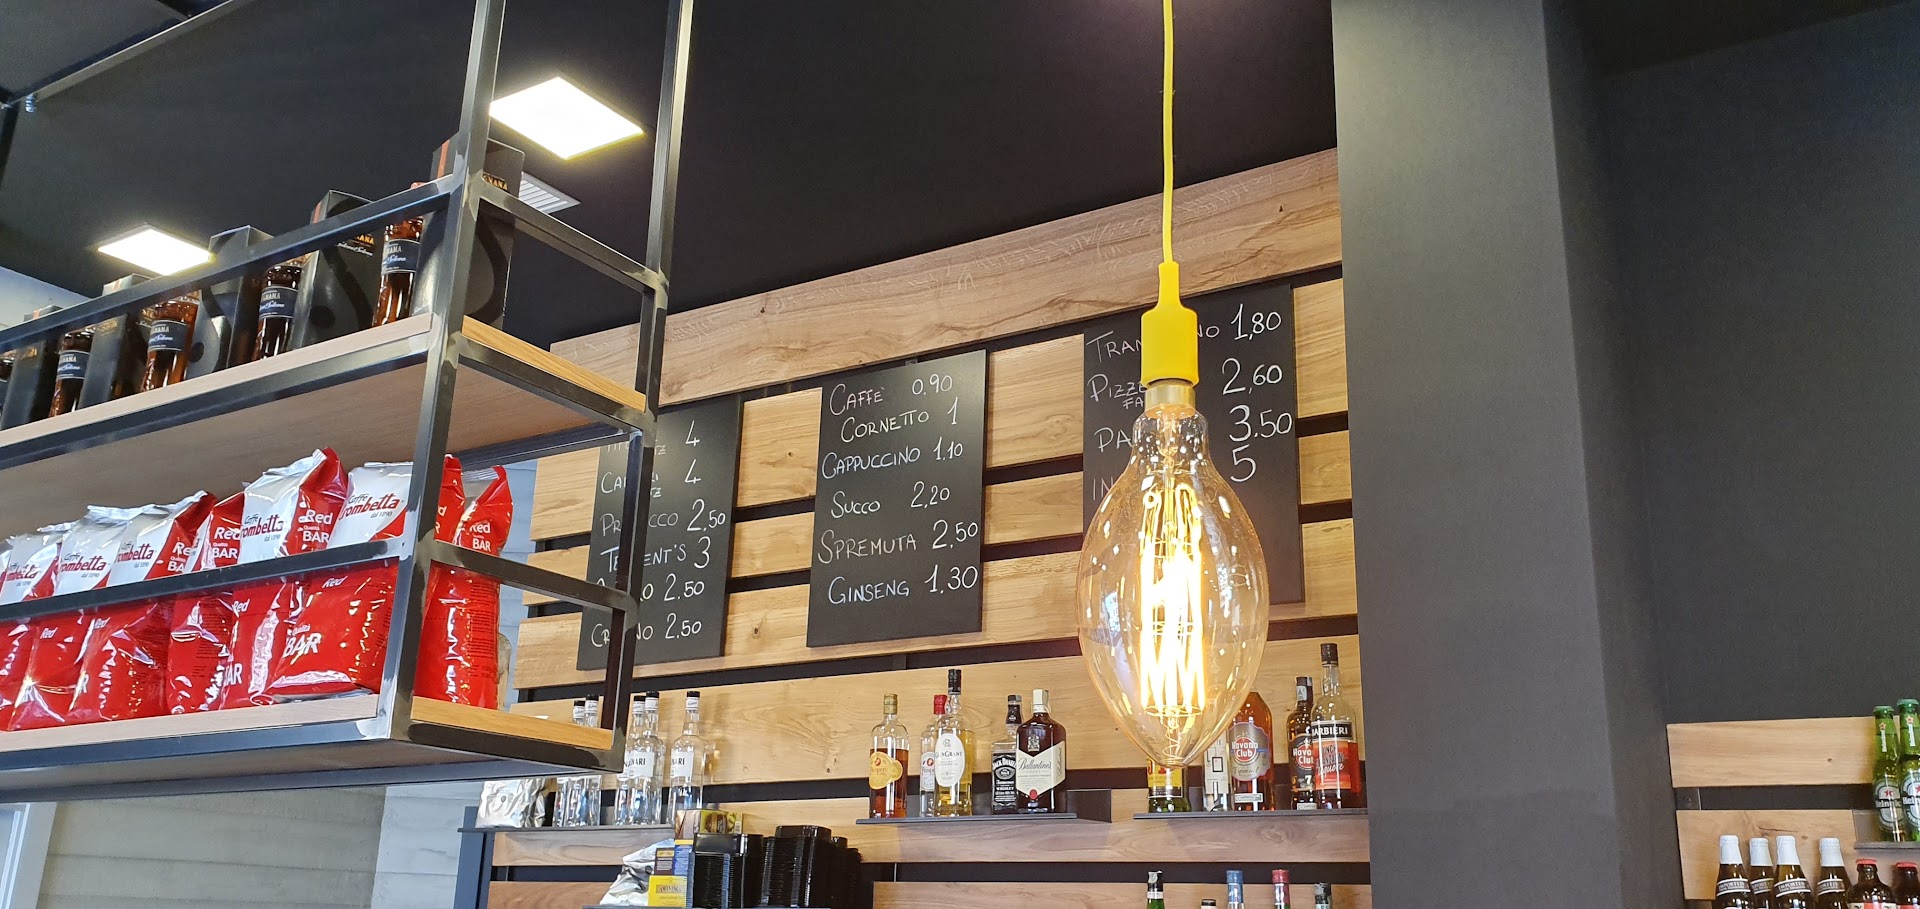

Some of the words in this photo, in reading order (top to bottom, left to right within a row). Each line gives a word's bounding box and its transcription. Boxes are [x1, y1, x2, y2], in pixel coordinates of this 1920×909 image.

[1230, 303, 1281, 340] 1,80
[1222, 357, 1283, 396] 2,60
[840, 409, 930, 443] CORNETTO
[947, 396, 959, 426] 1
[685, 420, 701, 447] 4
[821, 446, 921, 480] CAPPUCCINO
[933, 436, 963, 461] 1.10
[1230, 444, 1257, 482] 5
[684, 458, 702, 484] 4
[305, 509, 333, 525] Red
[338, 493, 401, 521] rombetta
[830, 490, 881, 519] SUCCO
[240, 513, 285, 538] rombetta
[302, 531, 330, 543] BAR
[115, 543, 154, 563] rombetta
[172, 541, 193, 557] Re
[211, 548, 238, 560] BAR
[473, 538, 492, 552] BAR
[693, 536, 711, 569] 3
[817, 529, 918, 565] SPREMUTA
[59, 555, 107, 573] rombetta
[167, 562, 186, 573] BA
[321, 575, 349, 589] Red
[664, 573, 705, 601] 2.50
[828, 576, 910, 605] GINSENG
[924, 564, 979, 594] 1.30
[283, 632, 322, 659] BAR
[223, 663, 243, 687] AR
[1231, 741, 1259, 750] Havana
[1236, 749, 1253, 757] Club
[1293, 748, 1312, 757] Hava
[1304, 775, 1312, 785] 7
